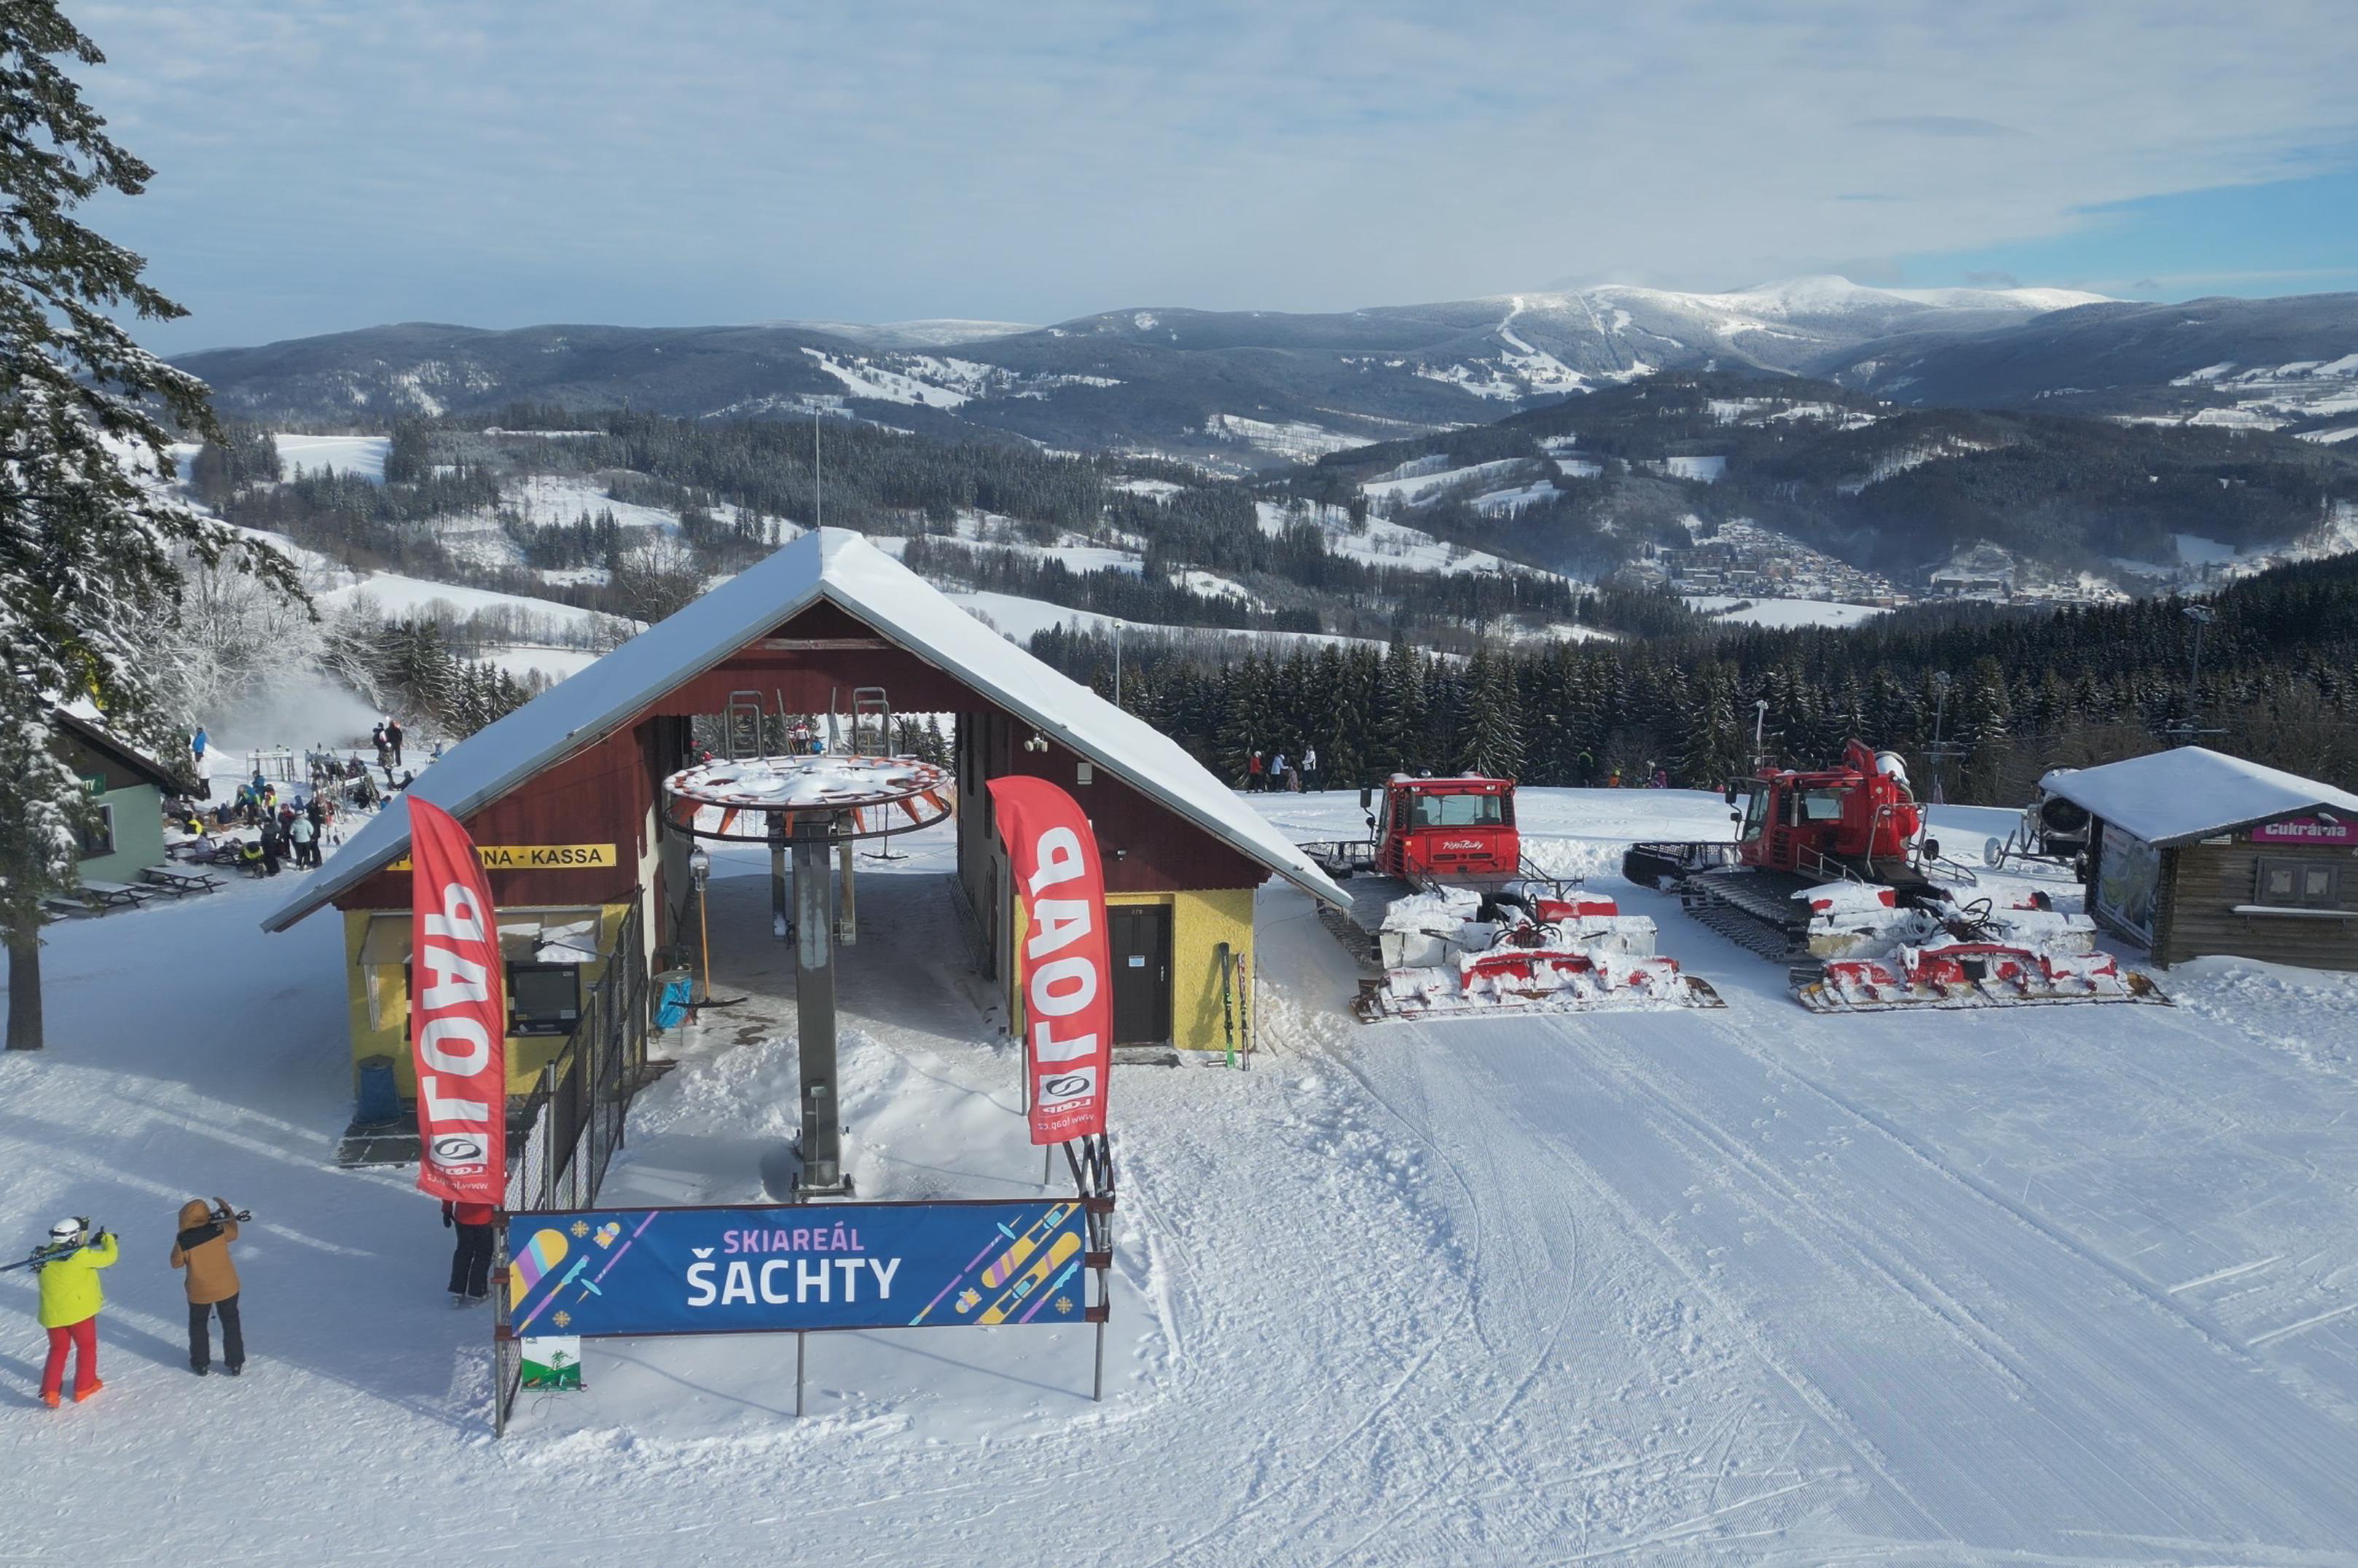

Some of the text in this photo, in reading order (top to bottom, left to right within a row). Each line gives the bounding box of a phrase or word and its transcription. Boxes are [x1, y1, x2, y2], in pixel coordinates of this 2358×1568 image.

[531, 849, 603, 865] KASSA
[724, 1220, 865, 1254] SKIAREÁL
[686, 1247, 901, 1306] ŠACHTY
